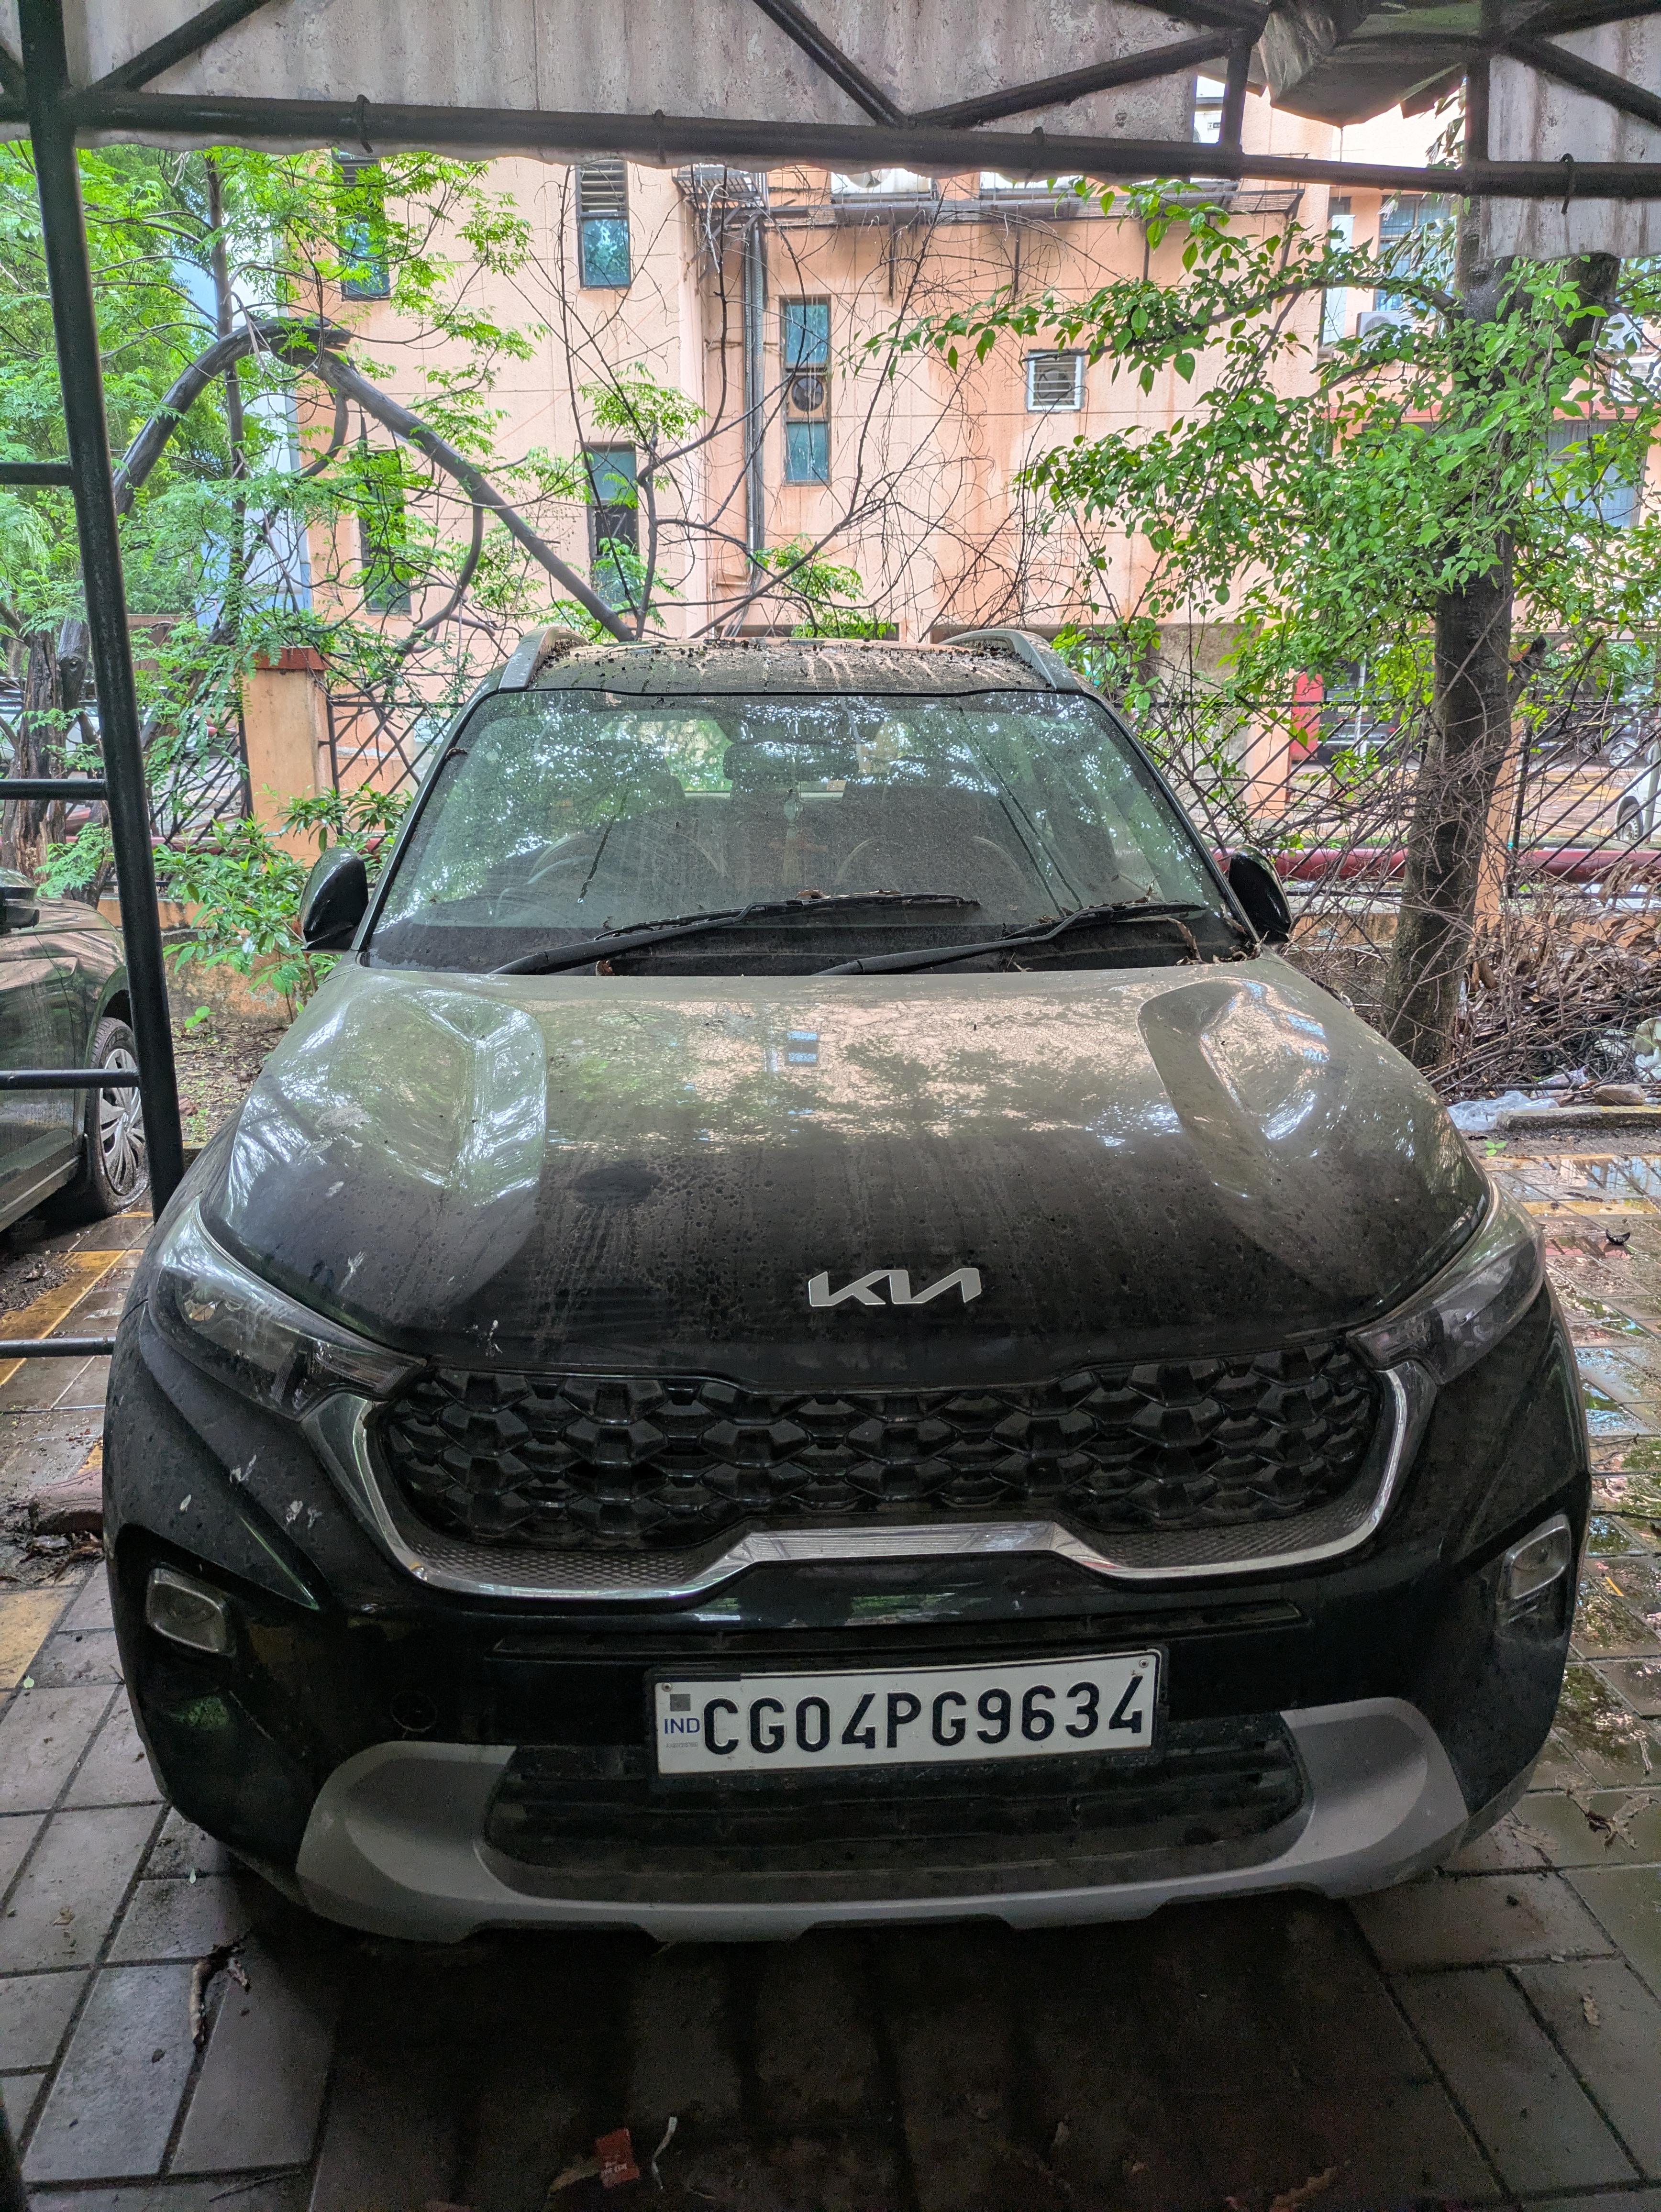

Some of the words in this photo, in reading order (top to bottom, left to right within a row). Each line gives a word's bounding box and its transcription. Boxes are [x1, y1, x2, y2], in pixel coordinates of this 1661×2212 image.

[808, 1267, 982, 1307] KIA
[664, 1718, 700, 1734] IND
[703, 1675, 1143, 1756] CG04PG9634
